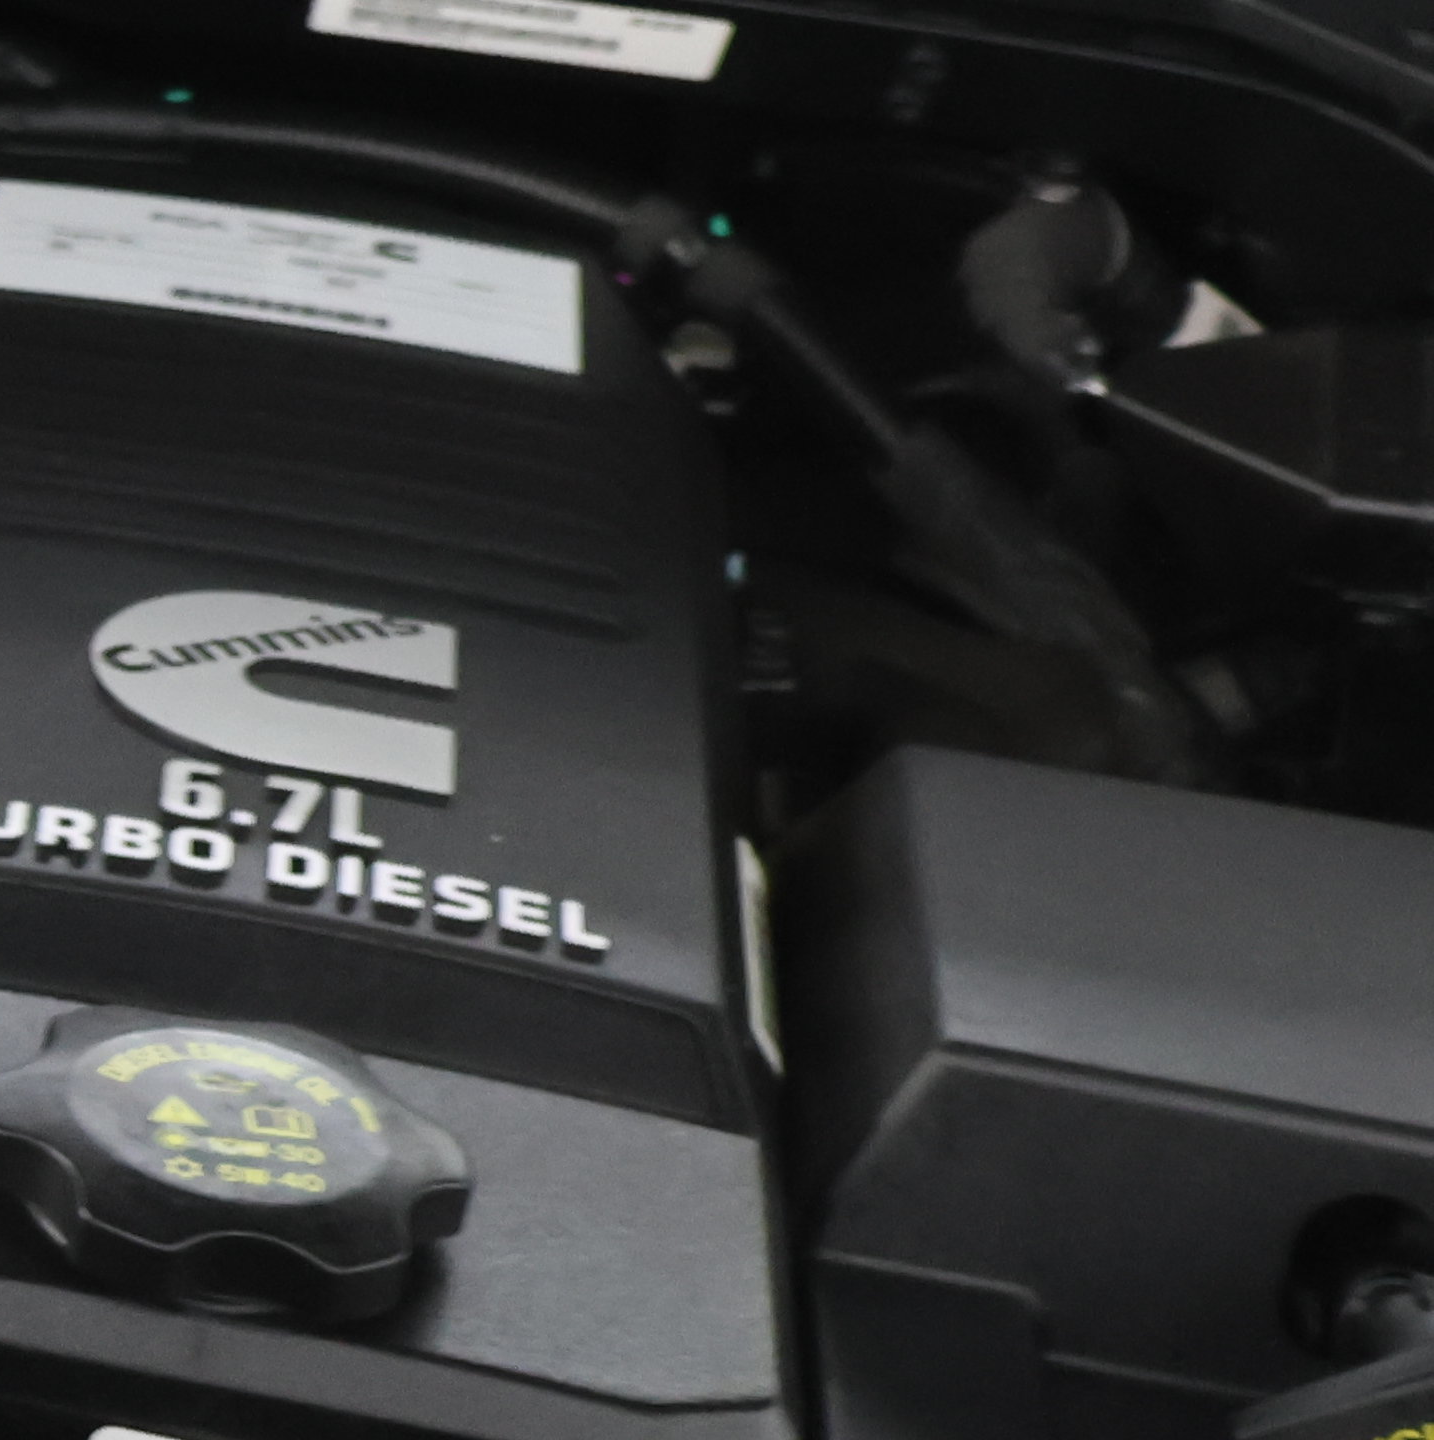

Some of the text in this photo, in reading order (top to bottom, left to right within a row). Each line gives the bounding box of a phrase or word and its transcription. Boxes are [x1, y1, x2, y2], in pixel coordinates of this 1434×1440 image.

[101, 613, 424, 673] Cummins
[158, 758, 384, 849] 6.7L
[265, 841, 611, 951] DIESEL
